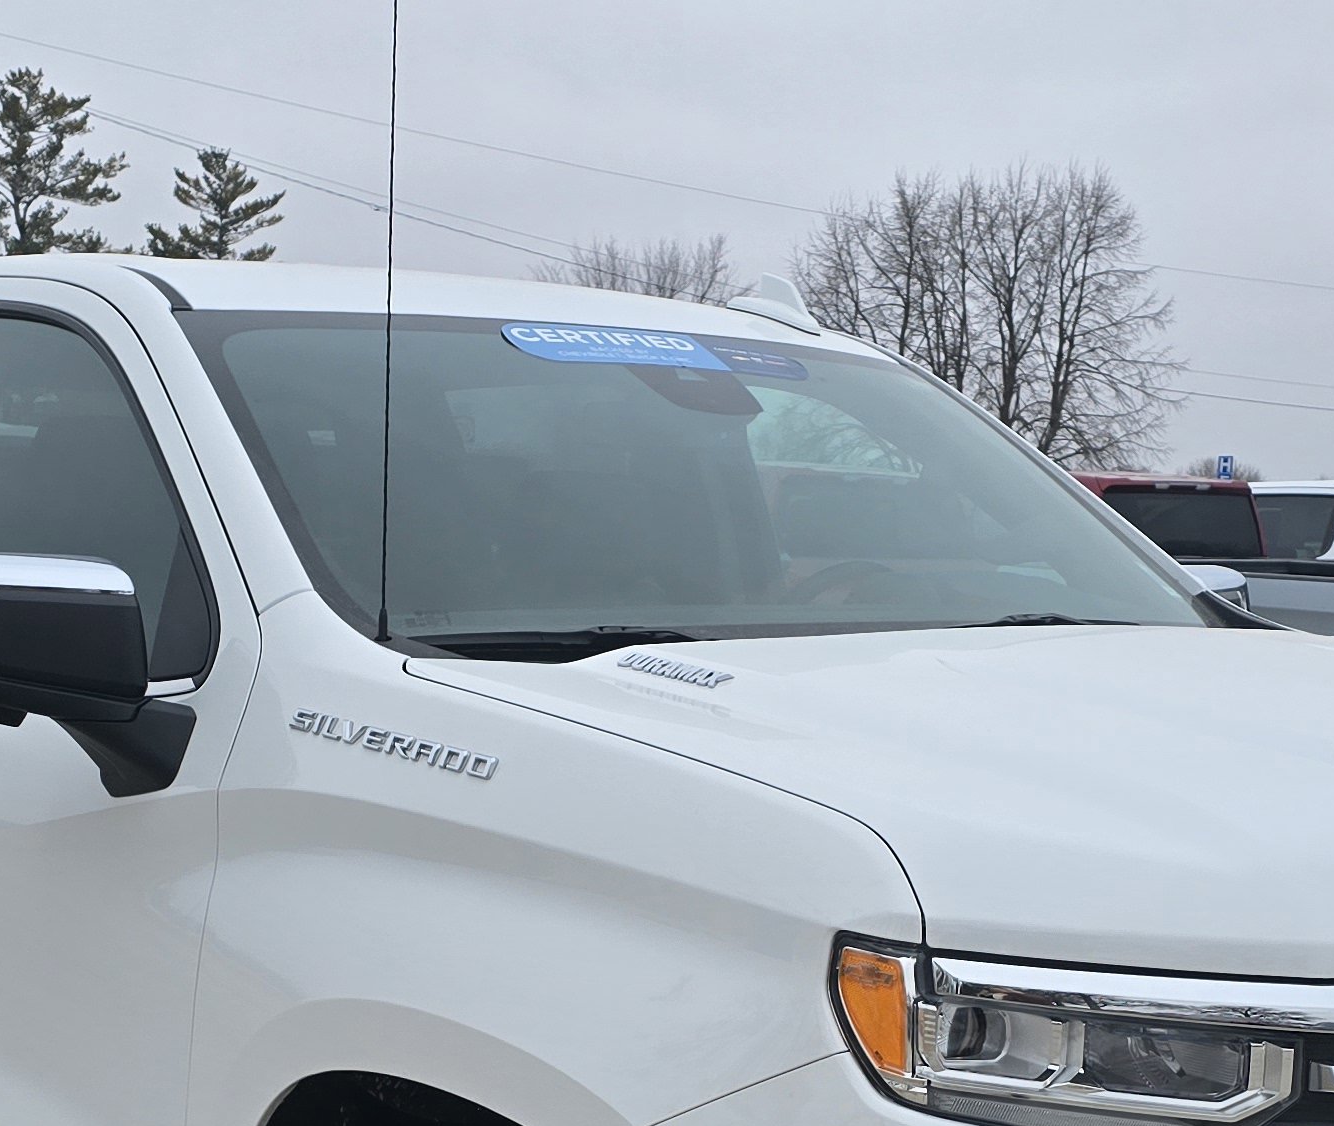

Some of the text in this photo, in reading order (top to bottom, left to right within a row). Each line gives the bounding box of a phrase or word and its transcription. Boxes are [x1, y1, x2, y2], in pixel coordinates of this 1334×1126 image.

[510, 326, 696, 351] CERTIFIED
[616, 650, 735, 688] DURAMAX
[288, 707, 500, 781] SILVERADO
